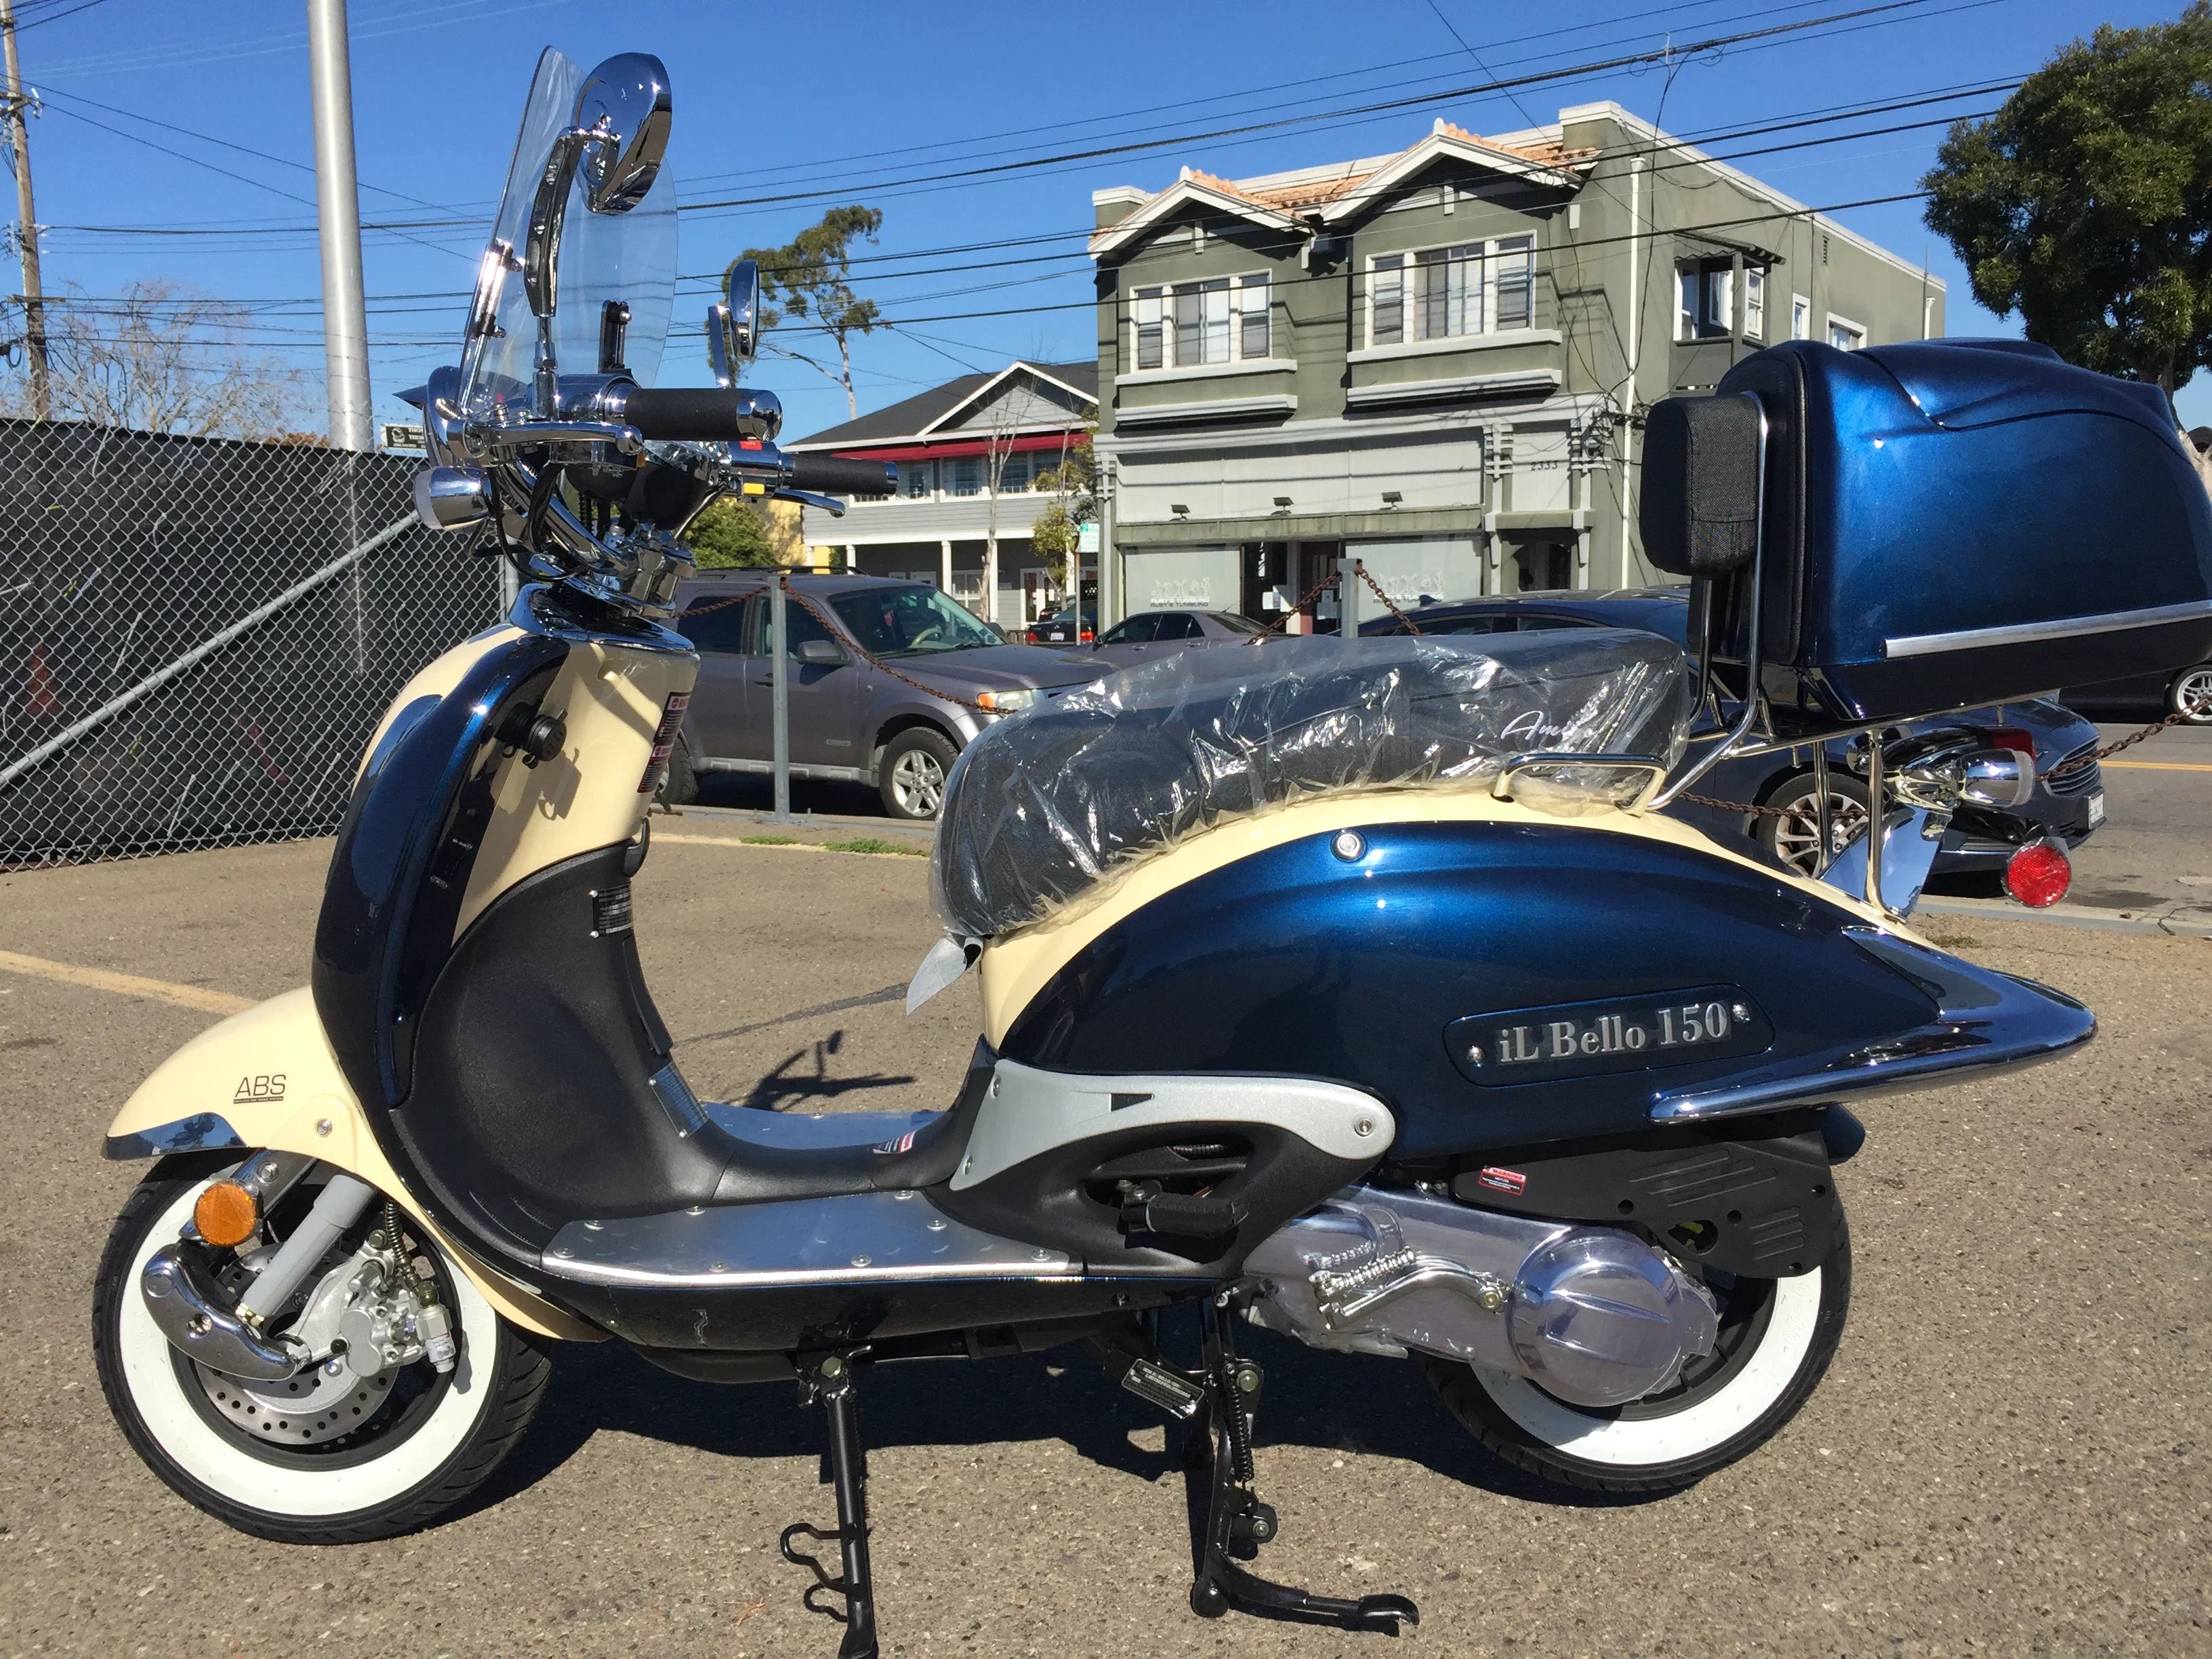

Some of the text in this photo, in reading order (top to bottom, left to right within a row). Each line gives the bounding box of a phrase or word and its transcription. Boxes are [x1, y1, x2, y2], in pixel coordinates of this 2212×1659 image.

[1530, 460, 1557, 471] 2333
[1500, 1002, 1727, 1063] iL Bello 150
[234, 1074, 286, 1097] ABS
